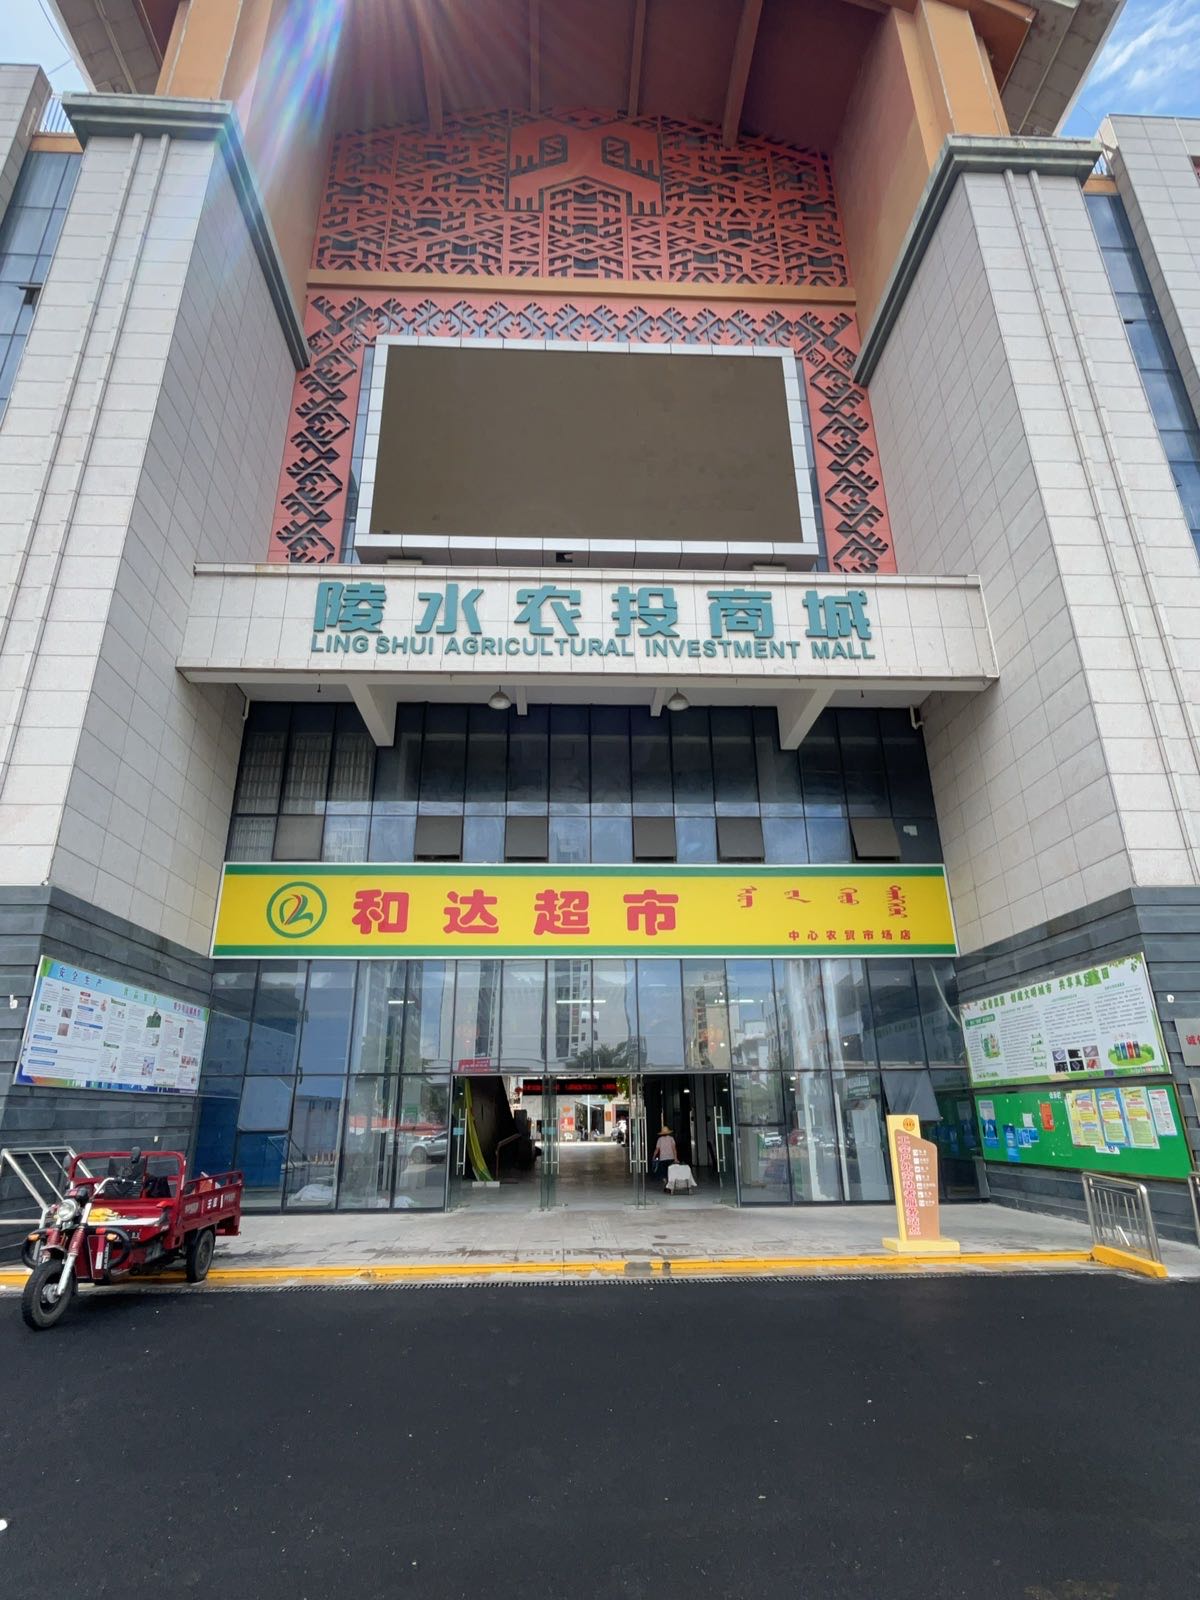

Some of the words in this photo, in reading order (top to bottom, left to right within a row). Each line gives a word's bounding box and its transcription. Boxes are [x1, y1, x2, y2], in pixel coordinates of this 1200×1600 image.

[313, 581, 872, 640] 陵水农投商城
[311, 634, 370, 654] LING
[376, 635, 434, 655] SHUI
[444, 637, 634, 657] AGRICULTURAL
[645, 639, 800, 659] INVESTMENT
[811, 641, 876, 660] MALL
[351, 888, 680, 936] 和达超市
[788, 929, 911, 941] 中心农贸市场店
[58, 966, 104, 987] 安全生产
